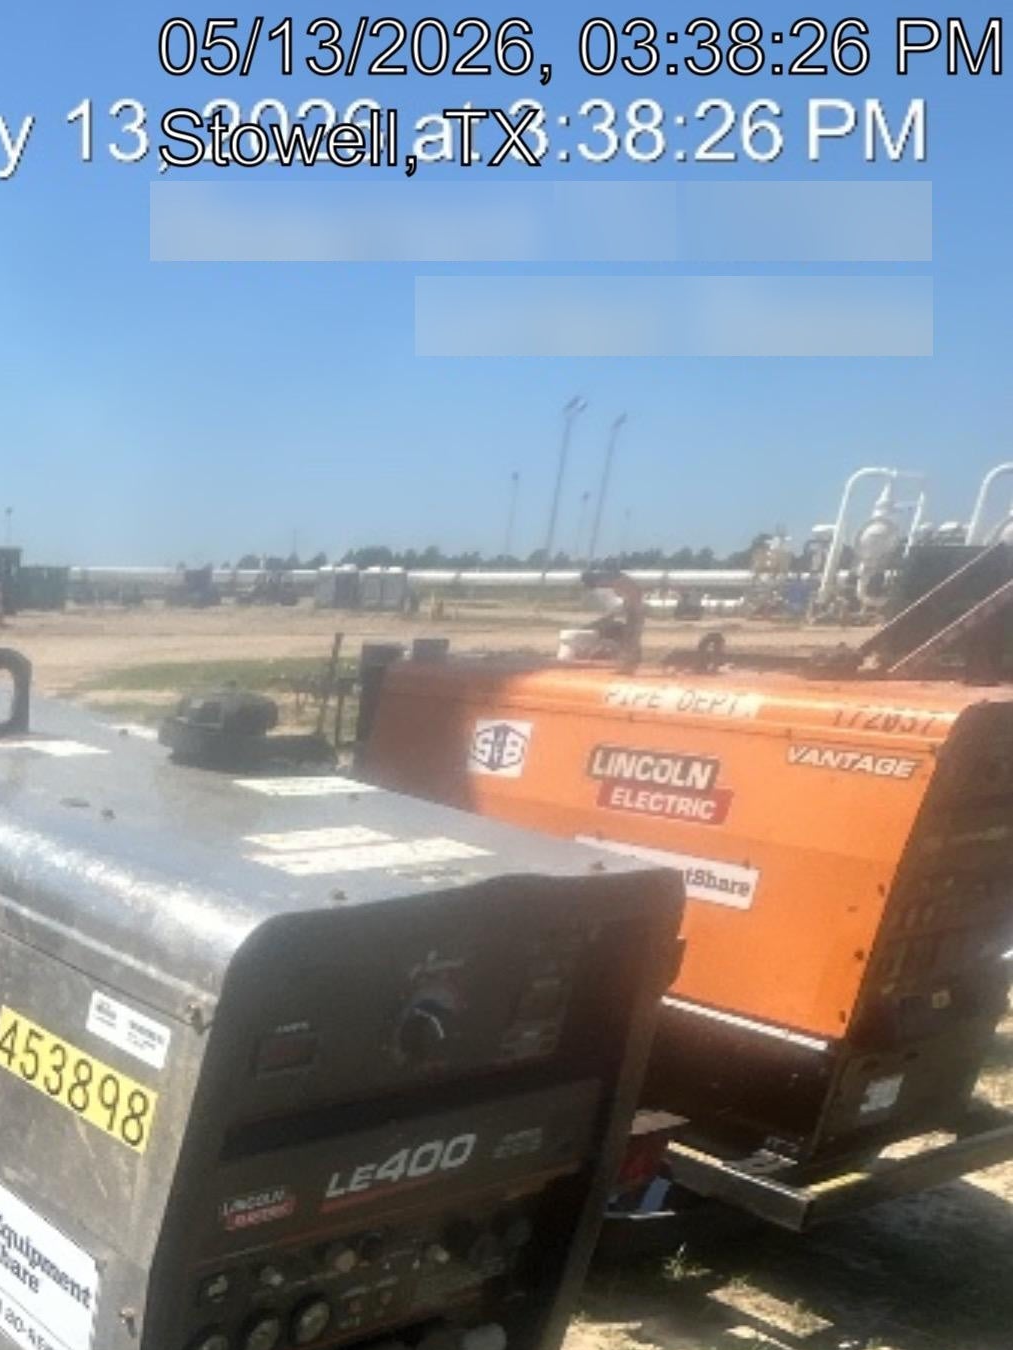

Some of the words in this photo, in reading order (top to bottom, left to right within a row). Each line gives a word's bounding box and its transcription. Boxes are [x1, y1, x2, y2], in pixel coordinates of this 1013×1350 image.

[593, 749, 713, 789] LINCOLN
[788, 746, 916, 778] VANTAGE
[610, 787, 717, 820] ELECTRIC
[325, 1133, 476, 1198] LE400
